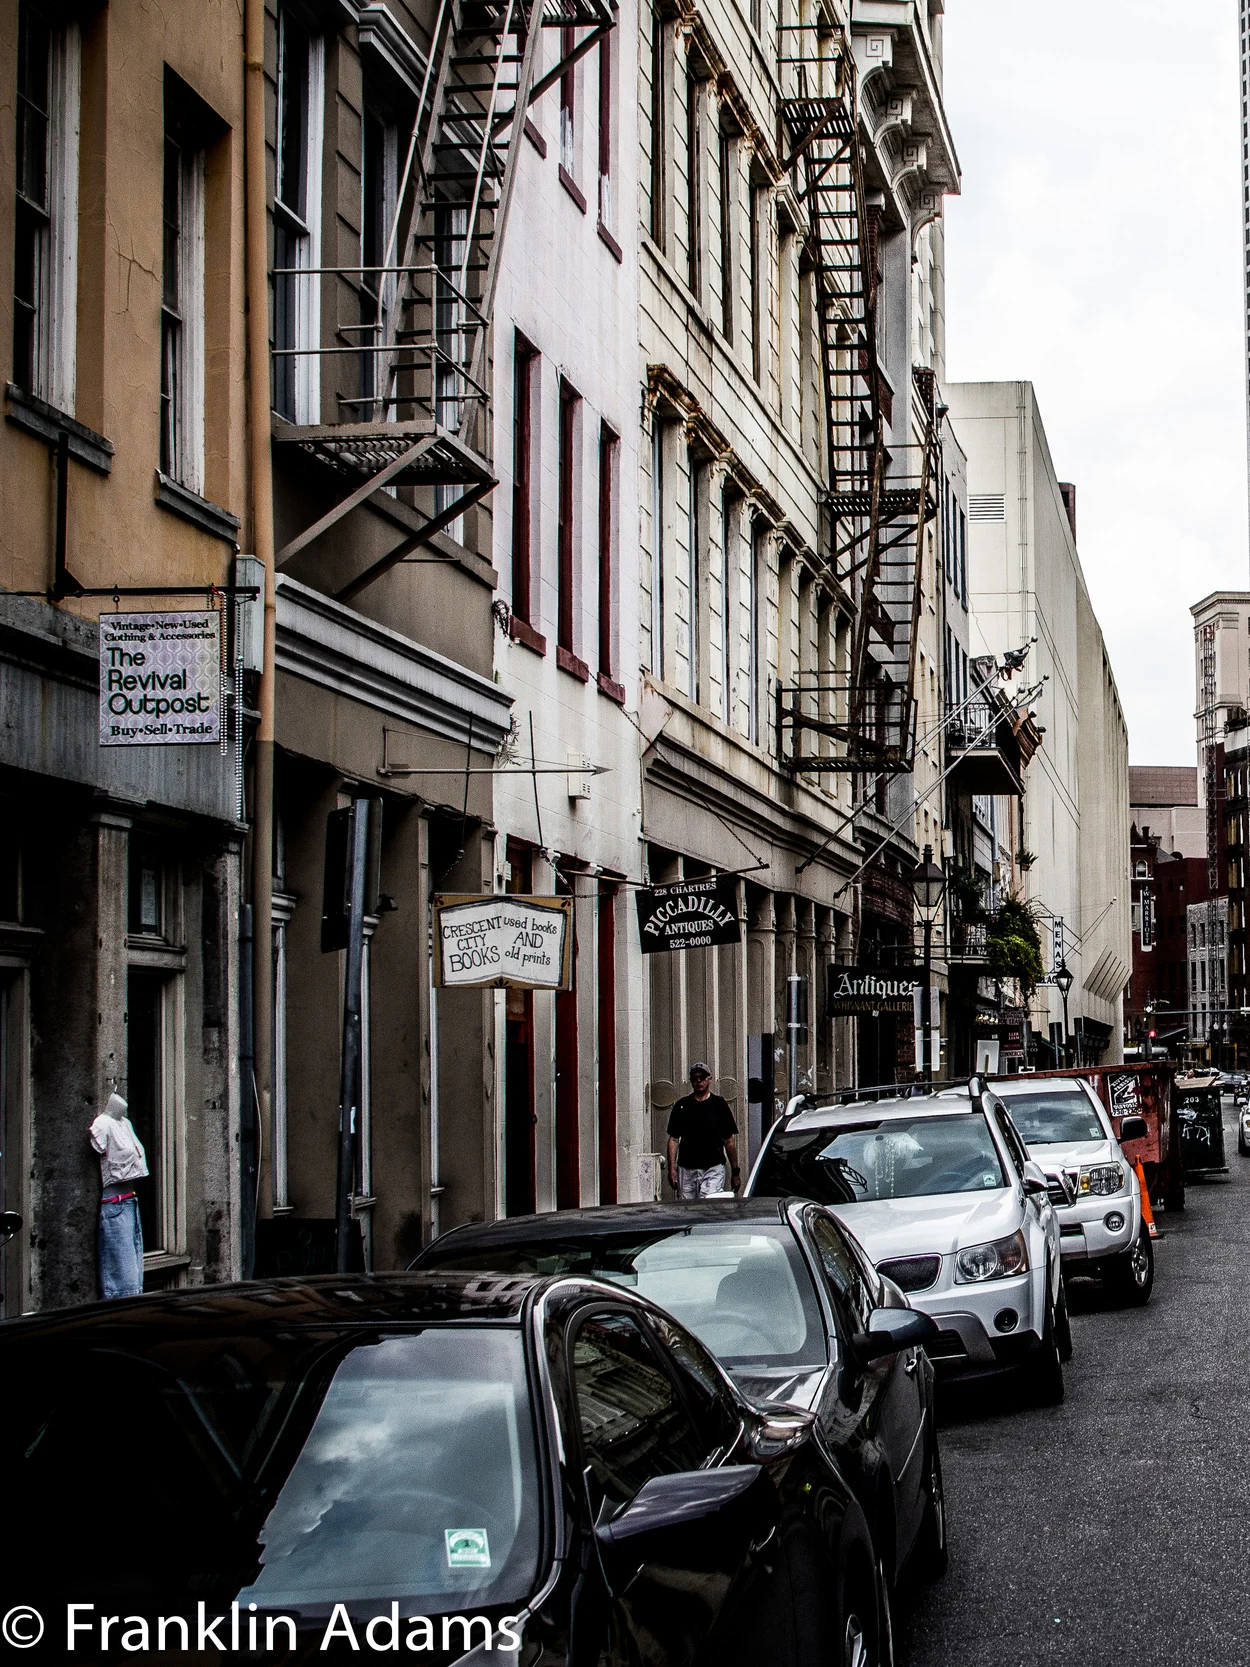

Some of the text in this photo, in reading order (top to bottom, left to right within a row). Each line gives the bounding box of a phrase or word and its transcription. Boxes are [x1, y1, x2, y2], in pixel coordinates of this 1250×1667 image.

[110, 619, 209, 633] Vintage New Used
[105, 630, 216, 643] Clothing & Accessories
[106, 647, 146, 667] The
[108, 669, 187, 692] Revival
[108, 692, 210, 719] Outpost
[110, 722, 213, 738] Buy Sell Trade
[653, 882, 717, 897] 228 CHARTRES
[644, 895, 736, 937] PICCADILLY
[1143, 899, 1151, 944] MARRIOTT
[442, 916, 558, 939] CRESCENT used books
[664, 919, 715, 936] ANTIQUES
[457, 933, 487, 951] CITY
[513, 931, 544, 949] AND
[669, 936, 712, 949] 522-0000
[1053, 920, 1063, 970] MENAS
[449, 945, 501, 973] BOOKS
[504, 946, 551, 967] old prints
[833, 972, 920, 1000] Antiques
[1184, 1096, 1200, 1104] 203
